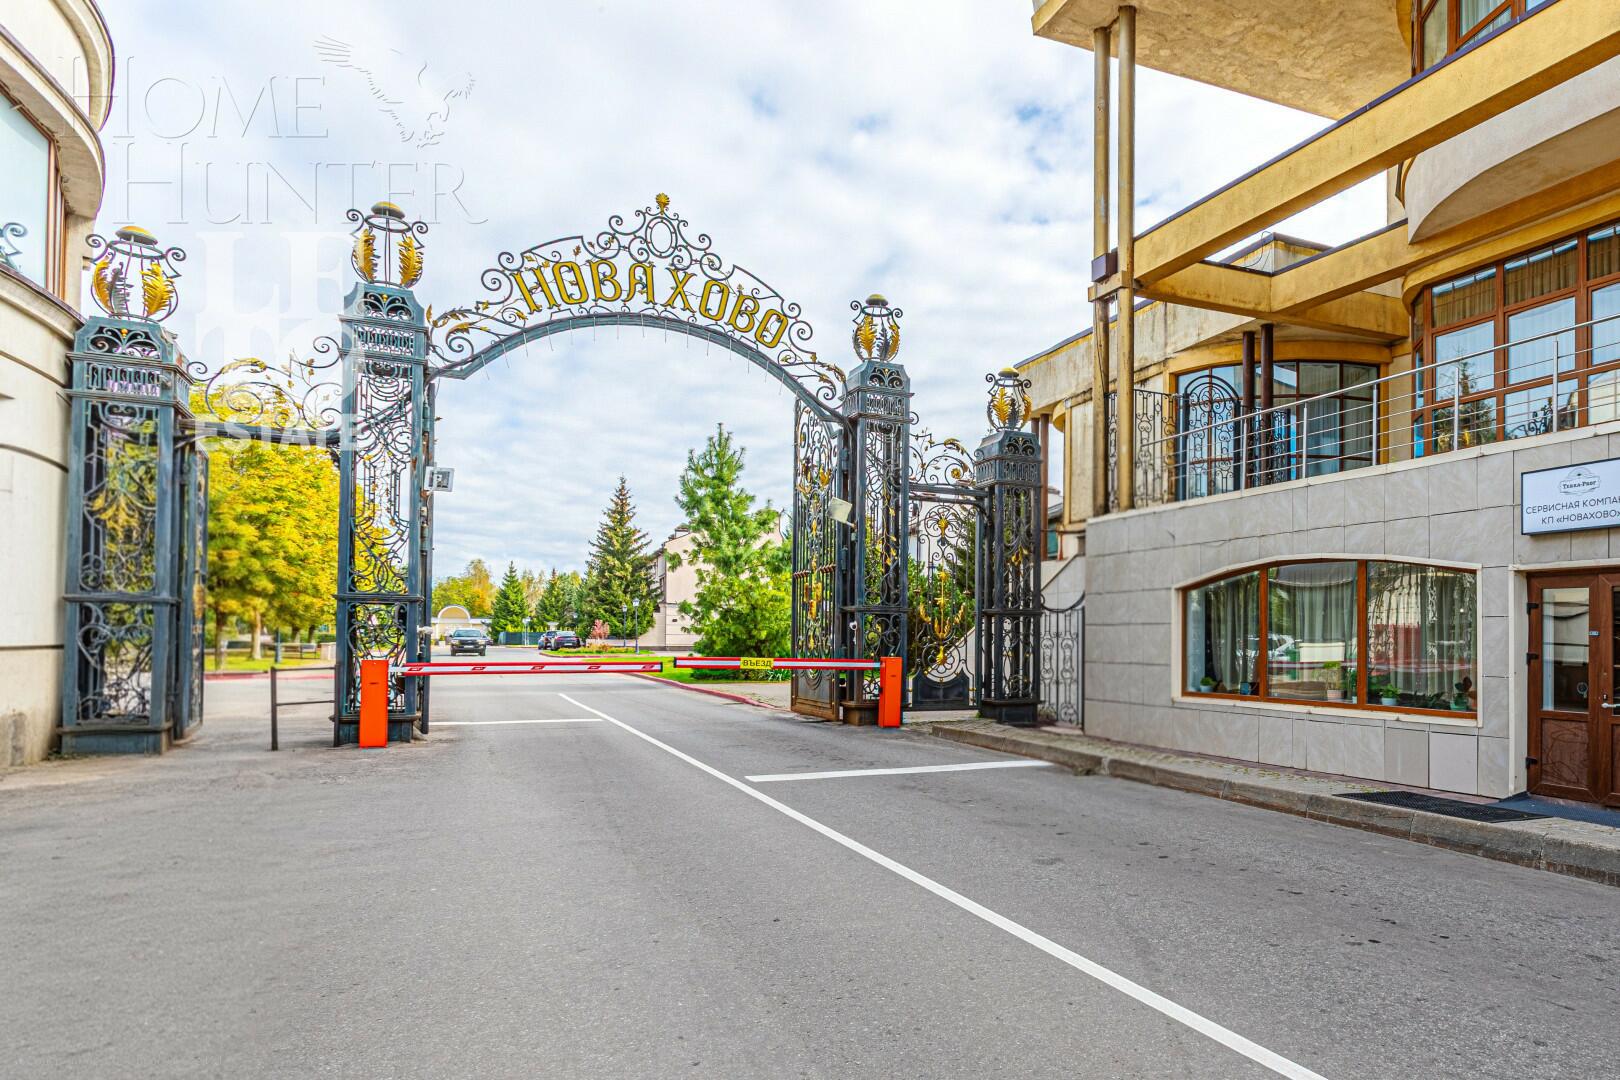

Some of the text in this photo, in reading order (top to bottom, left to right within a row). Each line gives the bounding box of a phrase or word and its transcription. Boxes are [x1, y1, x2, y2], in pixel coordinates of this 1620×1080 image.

[510, 258, 789, 349] НОВАХОВО
[1525, 500, 1580, 515] СЕРВИСНАЯ
[1541, 516, 1554, 525] КП
[743, 660, 772, 668] ВЪЕЗД
